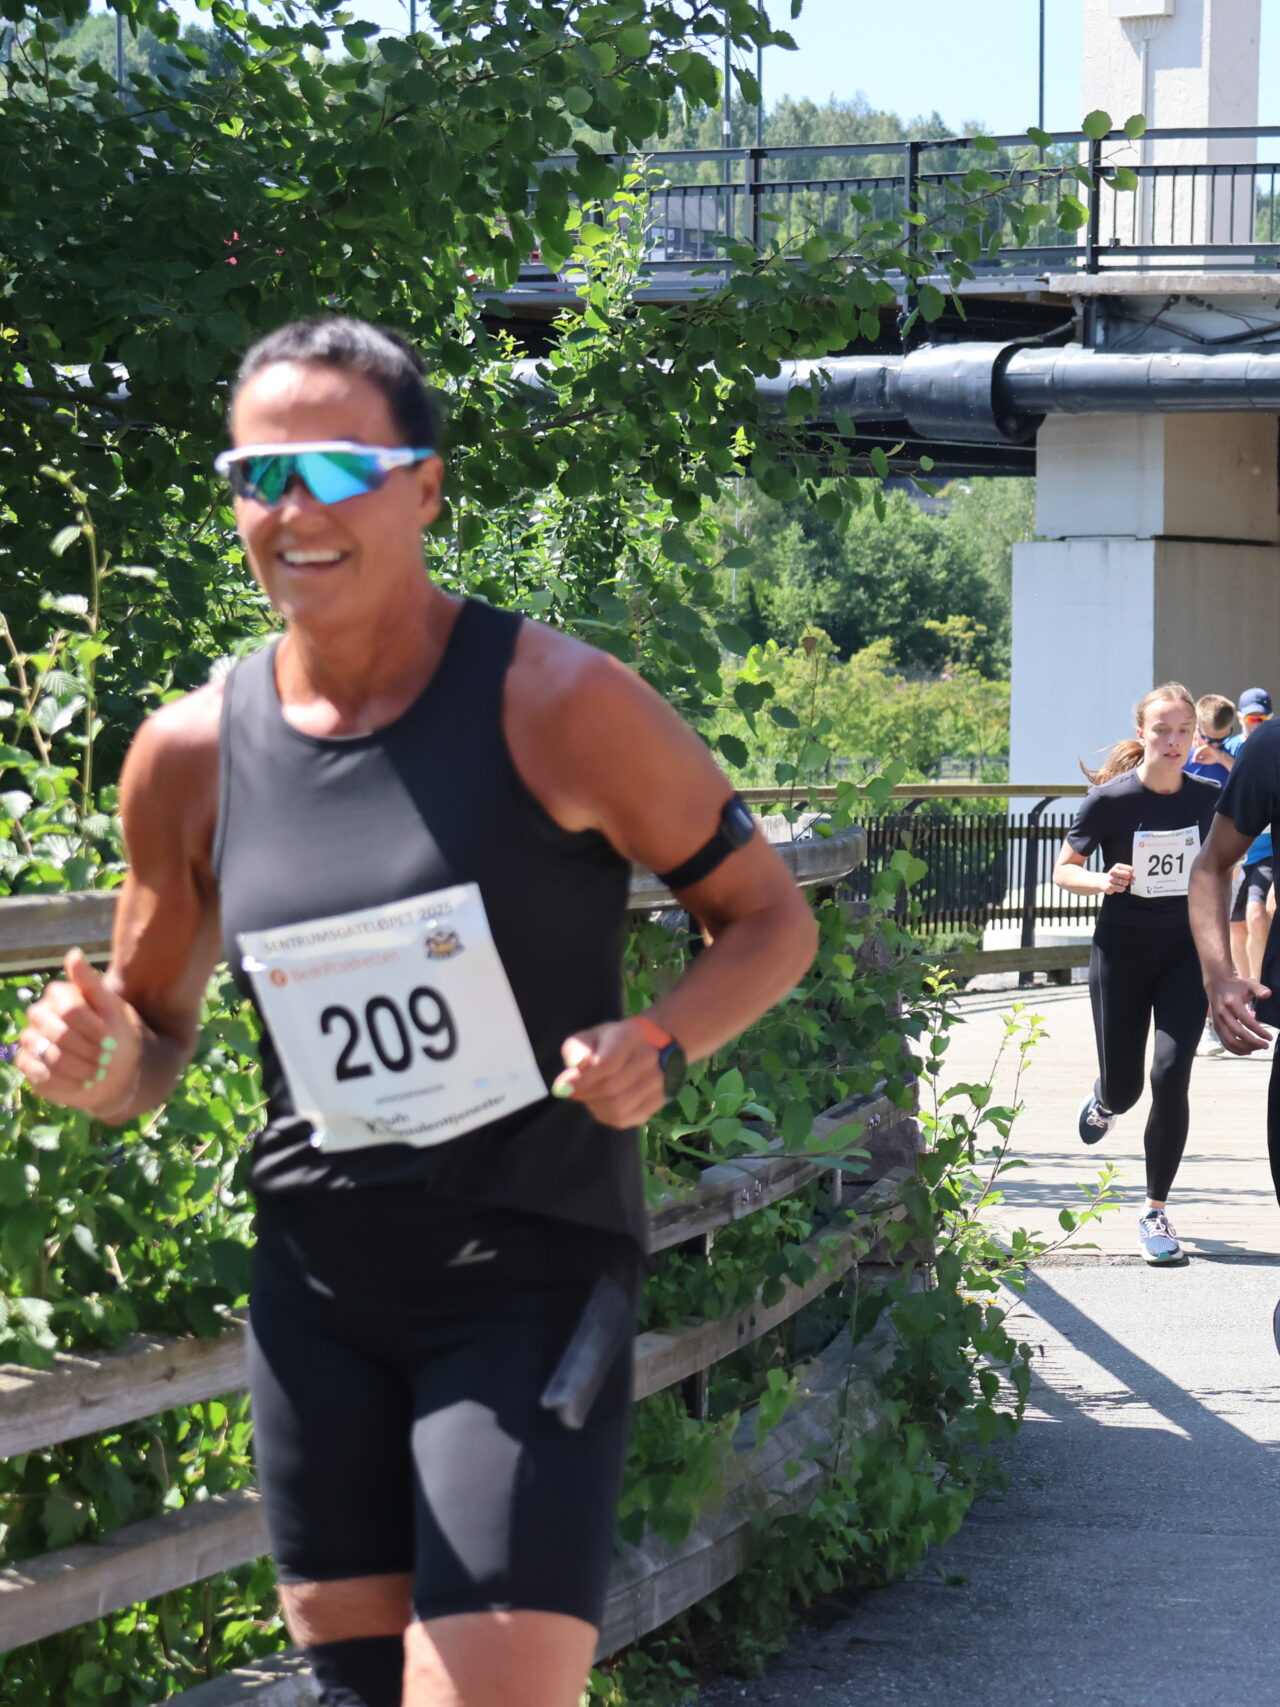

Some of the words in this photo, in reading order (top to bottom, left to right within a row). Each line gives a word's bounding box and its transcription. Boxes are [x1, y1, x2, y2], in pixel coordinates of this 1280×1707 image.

[1147, 853, 1184, 876] 261
[418, 903, 454, 921] 2025
[320, 985, 459, 1083] 209
